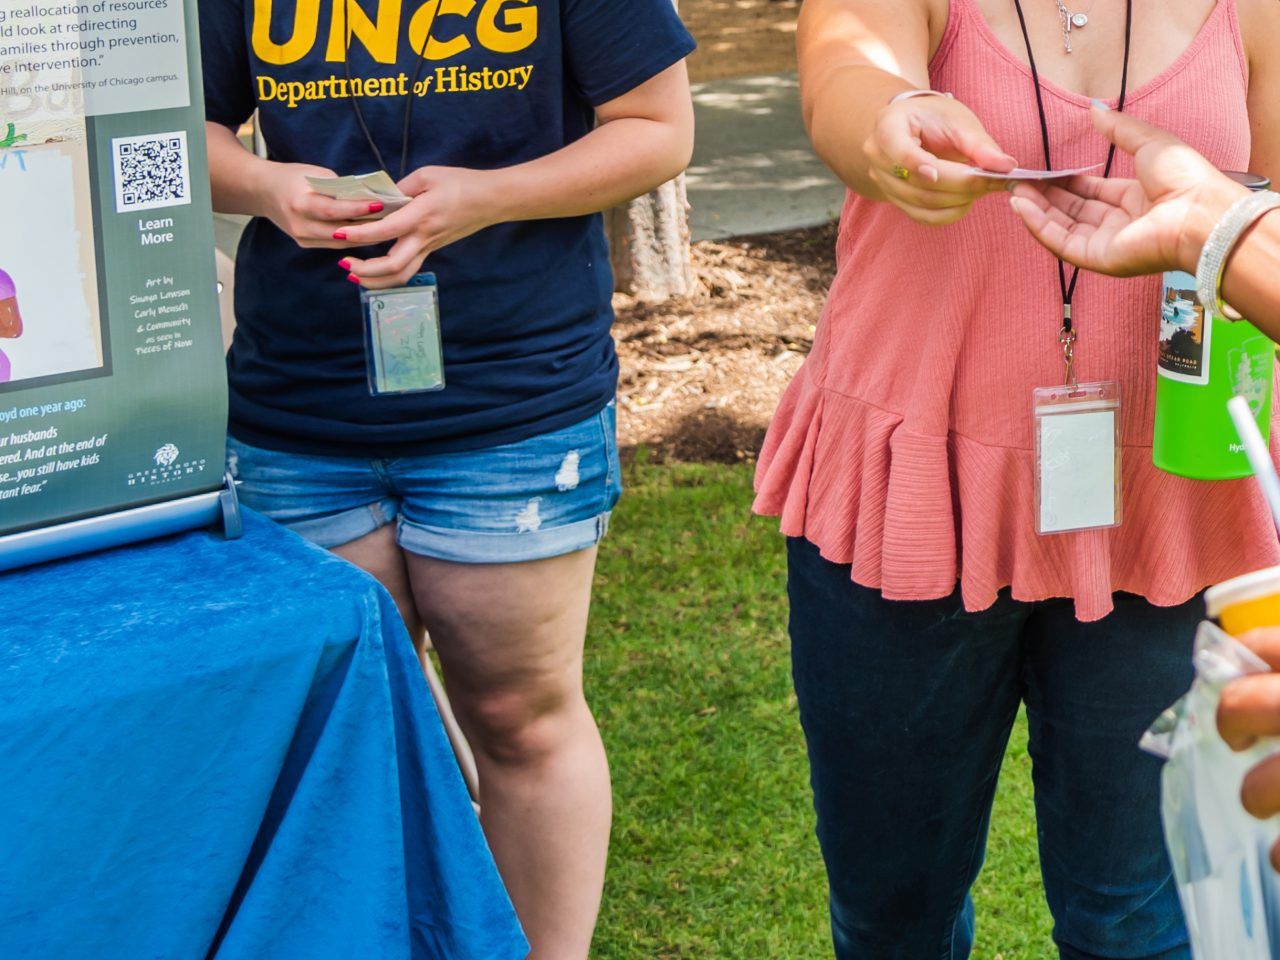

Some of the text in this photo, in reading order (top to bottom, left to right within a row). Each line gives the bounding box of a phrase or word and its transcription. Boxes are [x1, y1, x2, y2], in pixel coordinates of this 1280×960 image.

[10, 4, 90, 19] reallocation
[92, 0, 107, 13] of
[109, 0, 169, 12] resources
[16, 23, 47, 36] look
[49, 23, 64, 34] at
[66, 18, 138, 33] redirecting
[50, 37, 106, 52] through
[108, 32, 180, 51] prevention,
[20, 87, 33, 95] on
[34, 83, 50, 93] the
[51, 80, 97, 93] University
[98, 79, 109, 88] of
[109, 76, 145, 87] Chicago
[256, 64, 534, 108] Department of History
[138, 217, 174, 231] Learn
[140, 233, 174, 246] More
[145, 275, 174, 289] Art by
[134, 307, 156, 319] Carly
[136, 317, 191, 333] & Community
[162, 340, 173, 351] of
[19, 405, 39, 418] one
[40, 401, 63, 417] year
[64, 398, 87, 413] ago:
[10, 426, 58, 445] husbands
[24, 446, 45, 461] And
[46, 444, 57, 456] at
[58, 440, 75, 454] the
[76, 436, 95, 451] end
[95, 434, 108, 447] of
[36, 460, 56, 476] still
[56, 458, 80, 472] have
[80, 452, 101, 467] kids
